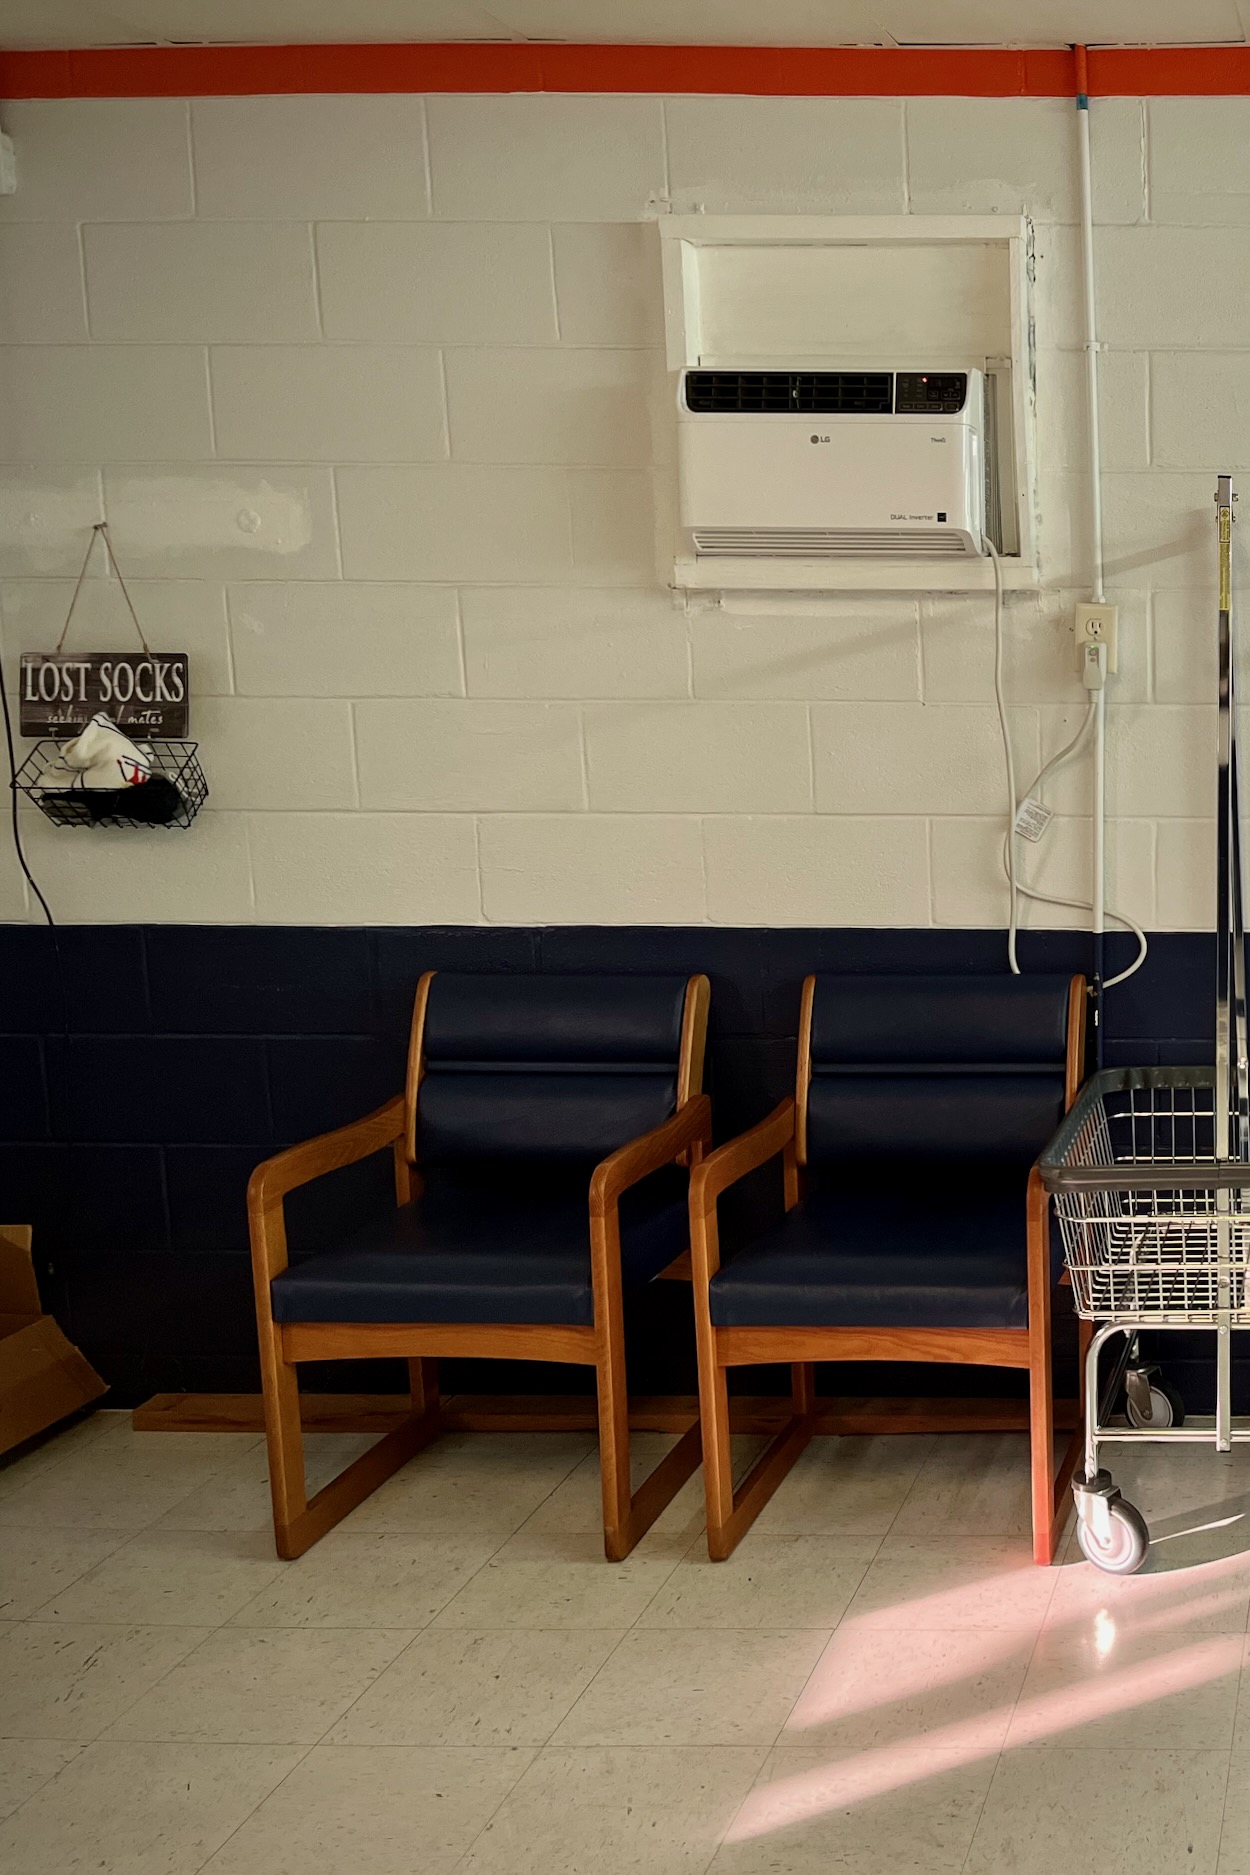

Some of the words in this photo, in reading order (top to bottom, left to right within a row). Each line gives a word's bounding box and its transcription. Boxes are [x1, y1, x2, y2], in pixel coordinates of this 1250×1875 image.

[24, 662, 91, 702] LOST
[100, 662, 184, 702] SOCKS
[127, 710, 163, 724] mates
